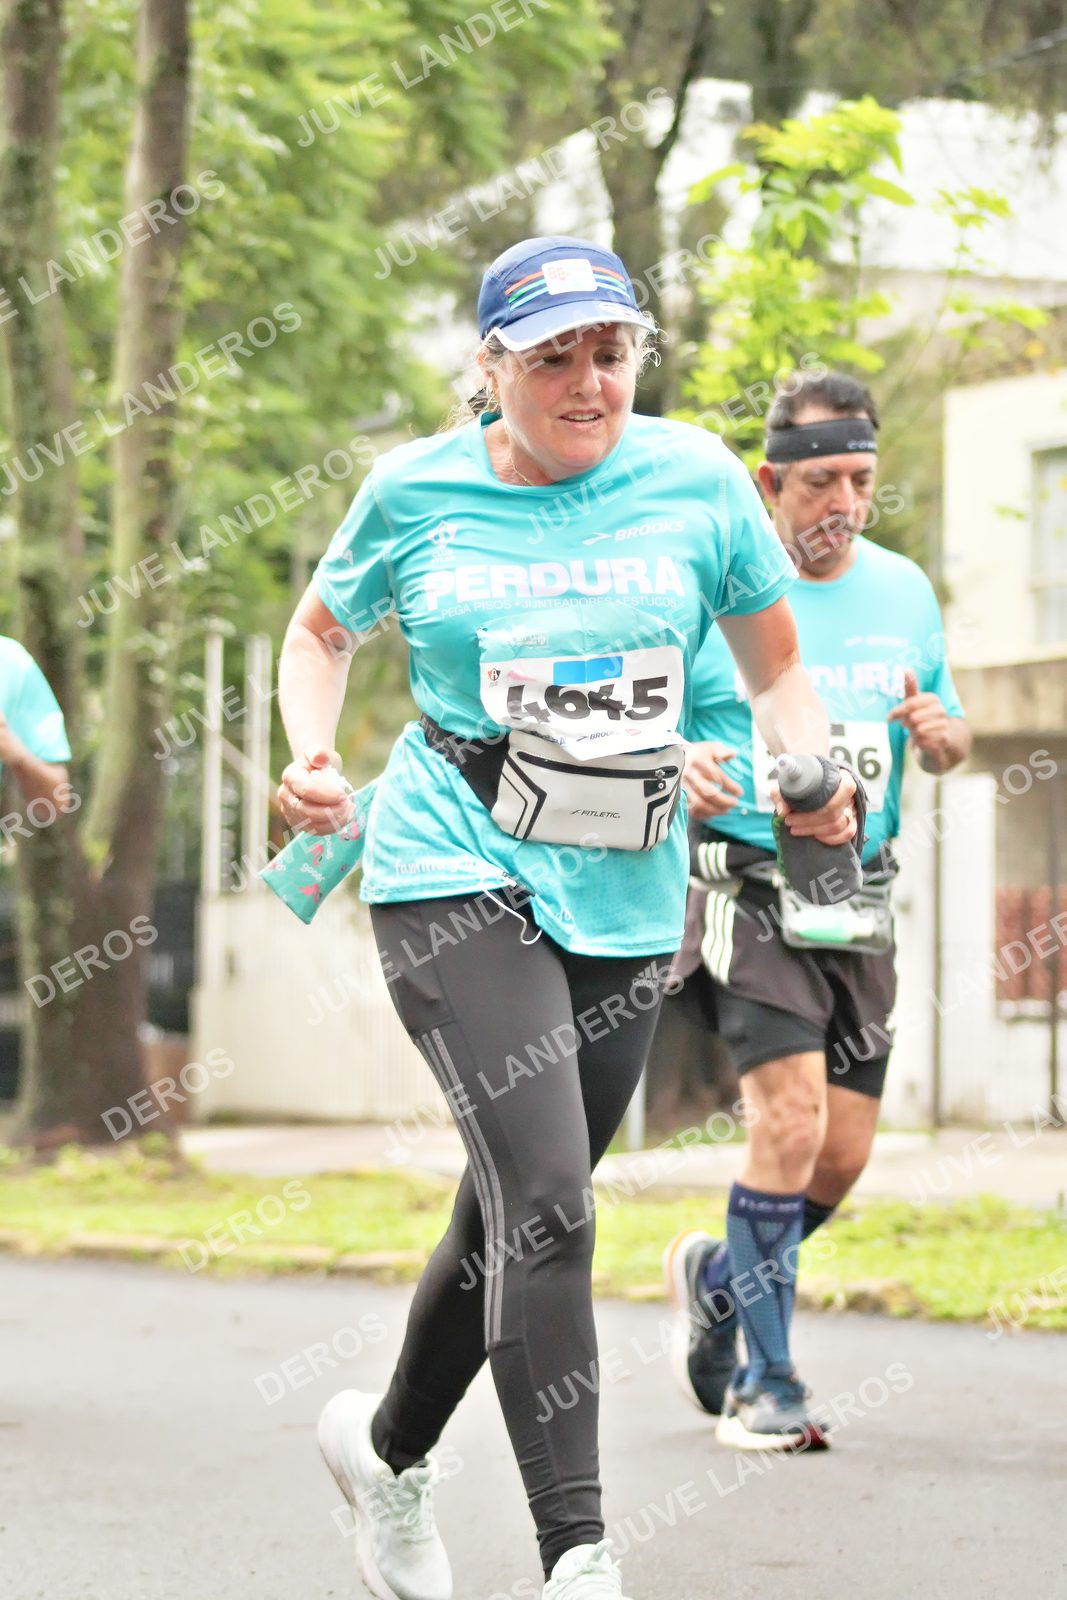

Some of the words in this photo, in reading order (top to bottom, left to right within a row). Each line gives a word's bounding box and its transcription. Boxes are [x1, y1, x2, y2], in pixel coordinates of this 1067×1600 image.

[615, 520, 686, 542] BROOKS
[423, 556, 685, 611] PERDURA
[441, 606, 472, 619] PEGA
[473, 600, 512, 612] PISOS
[522, 597, 614, 610] JUNTEADORES
[623, 596, 677, 608] ESTUCOS
